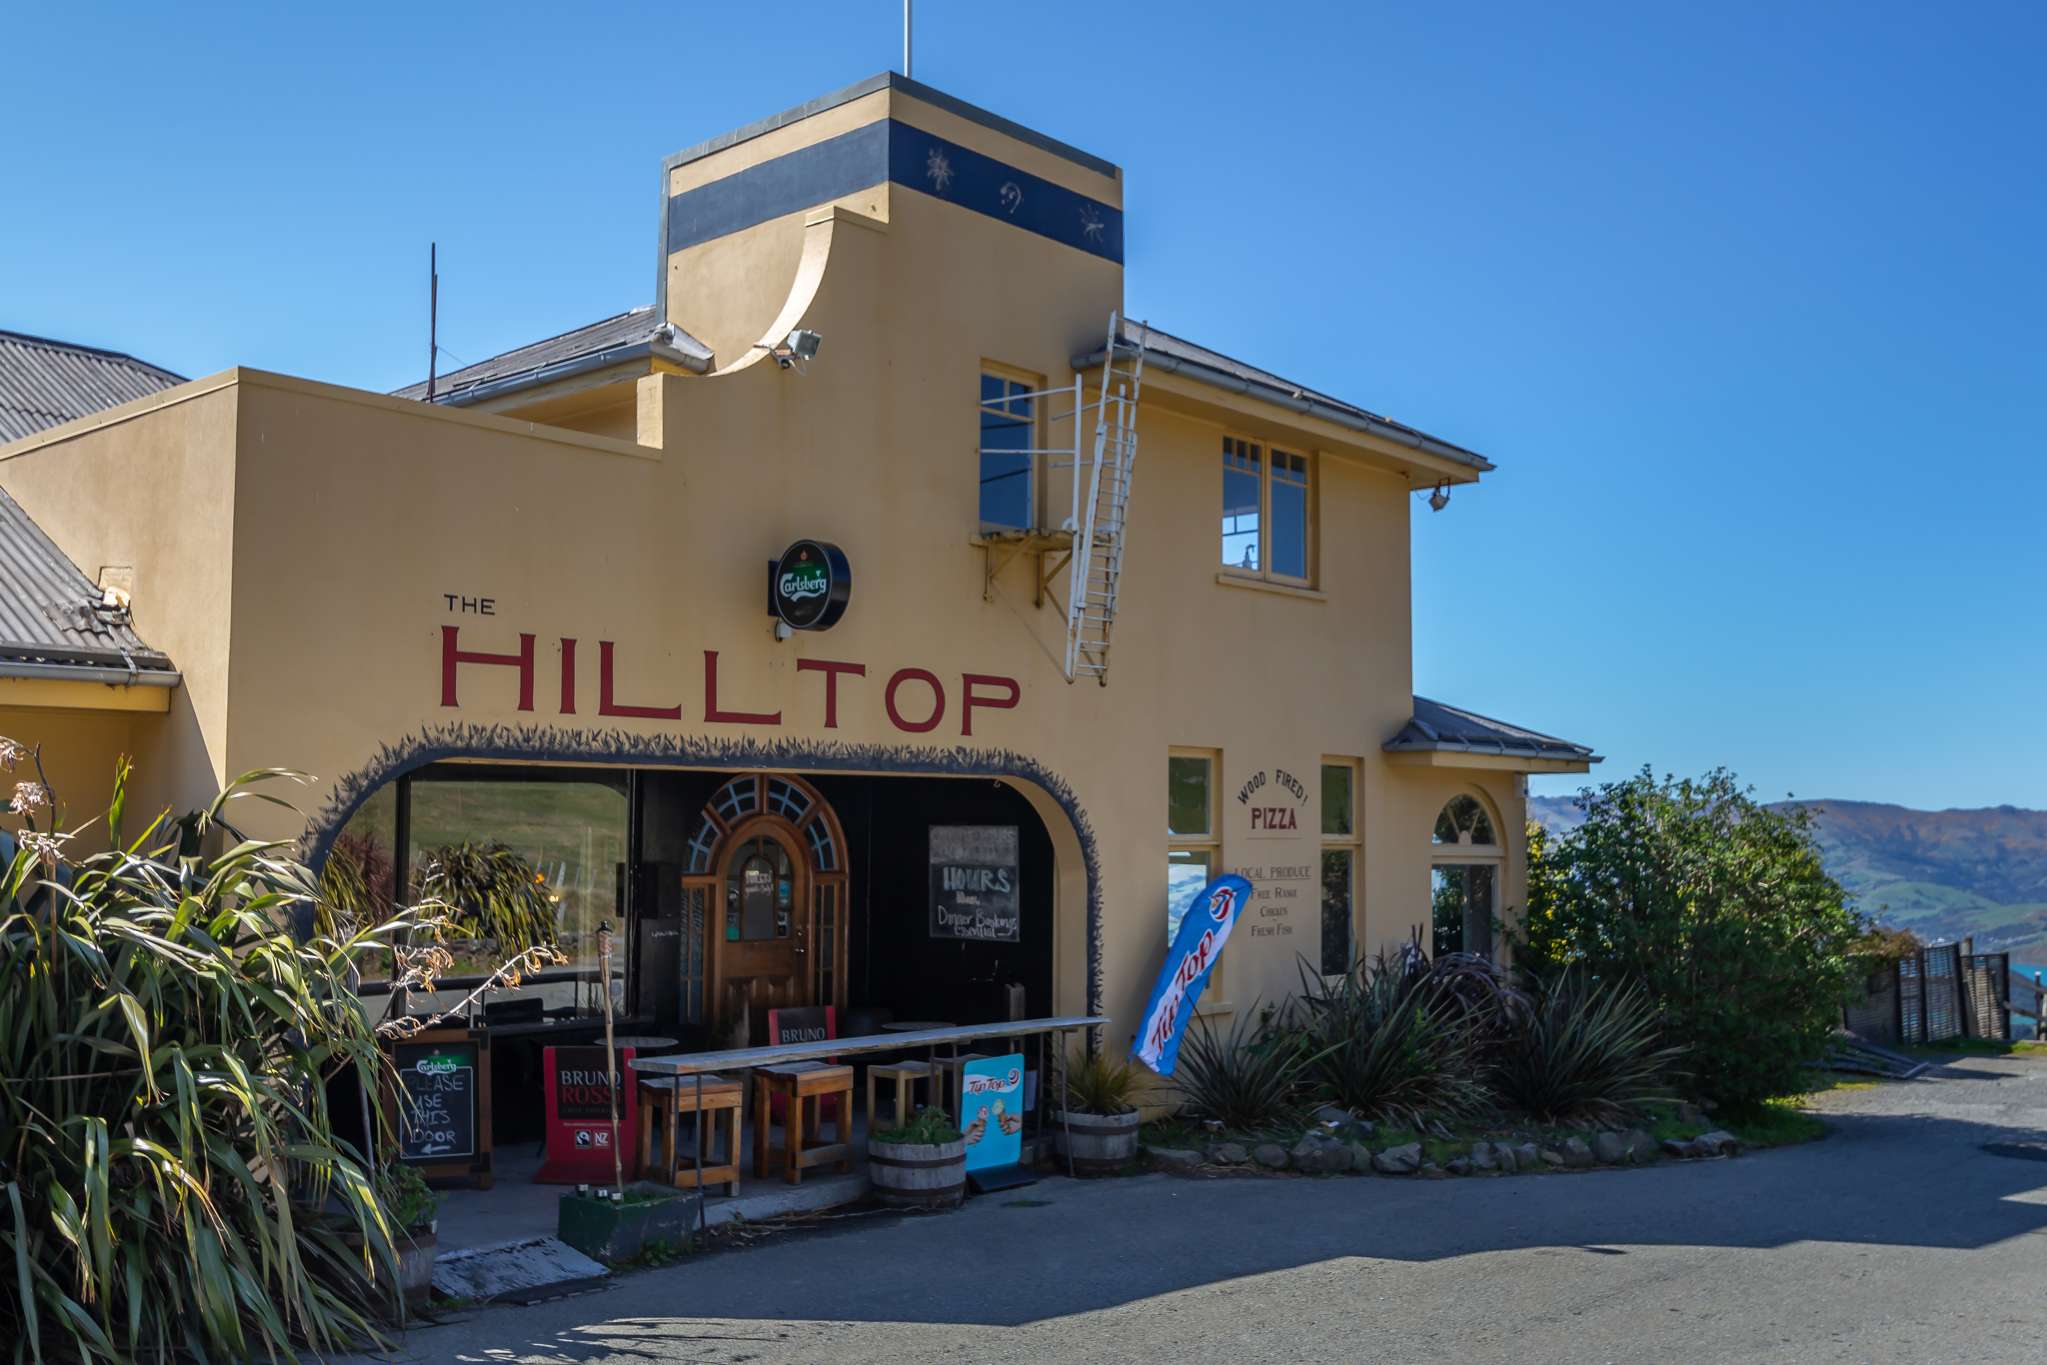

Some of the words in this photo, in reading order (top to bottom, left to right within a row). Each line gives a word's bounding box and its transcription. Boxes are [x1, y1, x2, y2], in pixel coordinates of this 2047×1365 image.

[780, 570, 826, 602] Carlsberg
[444, 594, 495, 615] THE
[441, 625, 1021, 736] HILLTOP
[1237, 770, 1266, 805] WOOD
[1251, 807, 1297, 830] PIZZA
[1270, 866, 1312, 878] PRODUCE
[1152, 993, 1181, 1055] Tip
[1174, 930, 1213, 992] Top
[782, 1026, 825, 1043] BRUNO
[416, 1059, 457, 1075] Carlsberg
[407, 1073, 465, 1092] PLEASE
[969, 1080, 987, 1094] Tip
[986, 1077, 1006, 1091] Top
[412, 1128, 457, 1144] DOOR
[594, 1131, 609, 1146] NZ
